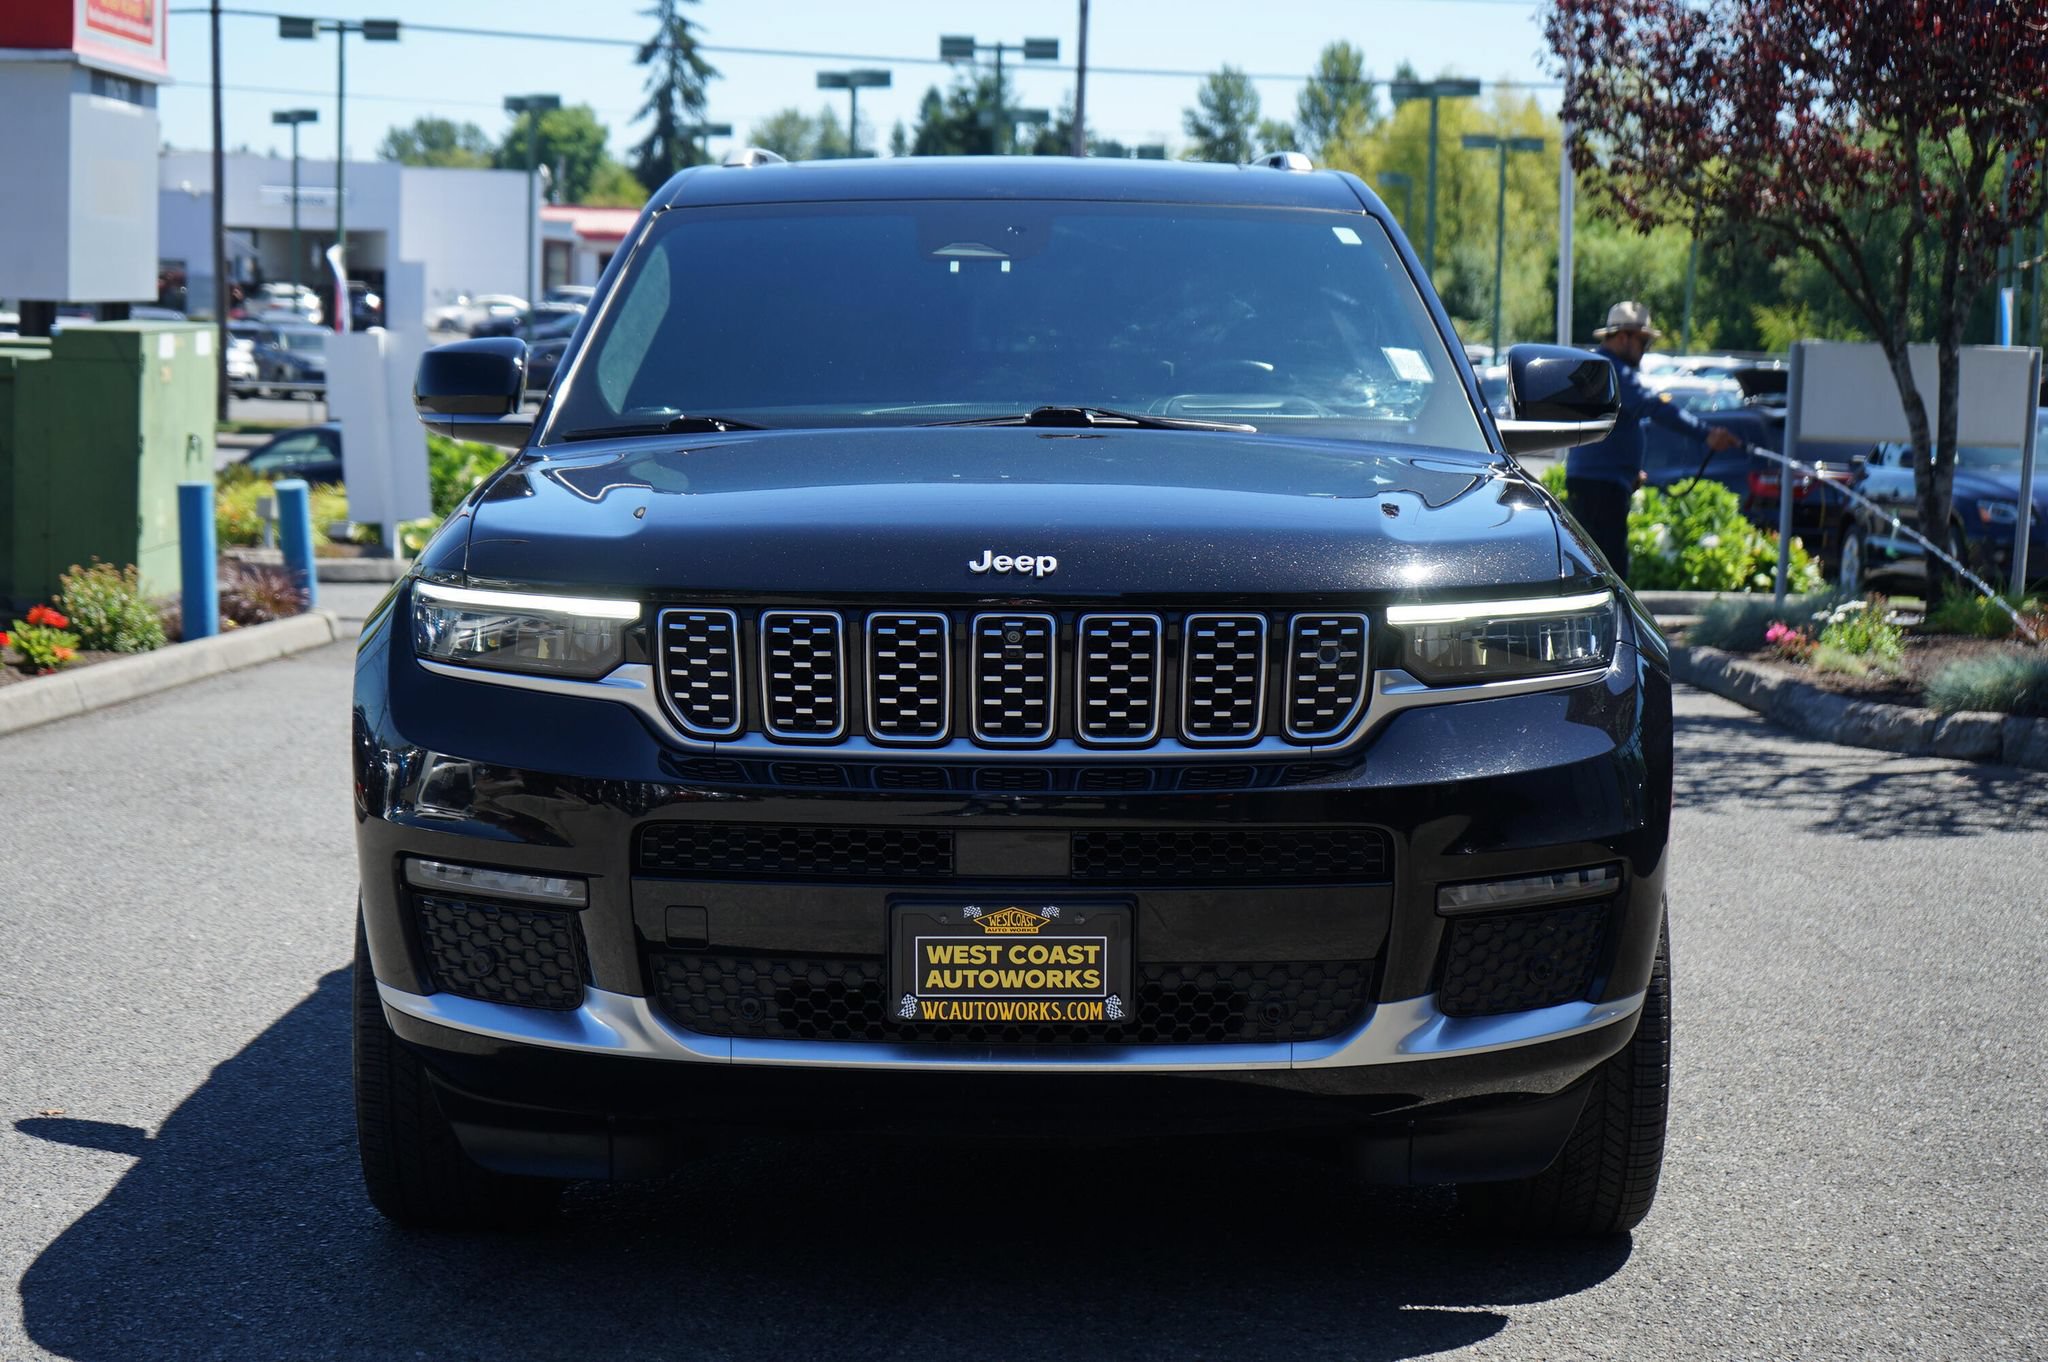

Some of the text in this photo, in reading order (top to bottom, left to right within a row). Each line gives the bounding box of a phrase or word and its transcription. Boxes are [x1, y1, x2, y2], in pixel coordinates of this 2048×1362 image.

[969, 550, 1057, 576] Jeep
[927, 945, 1100, 964] WEST COAST
[925, 969, 1100, 988] AUTOWORKS
[920, 1001, 1103, 1020] WCAUTOWORKS.COM
